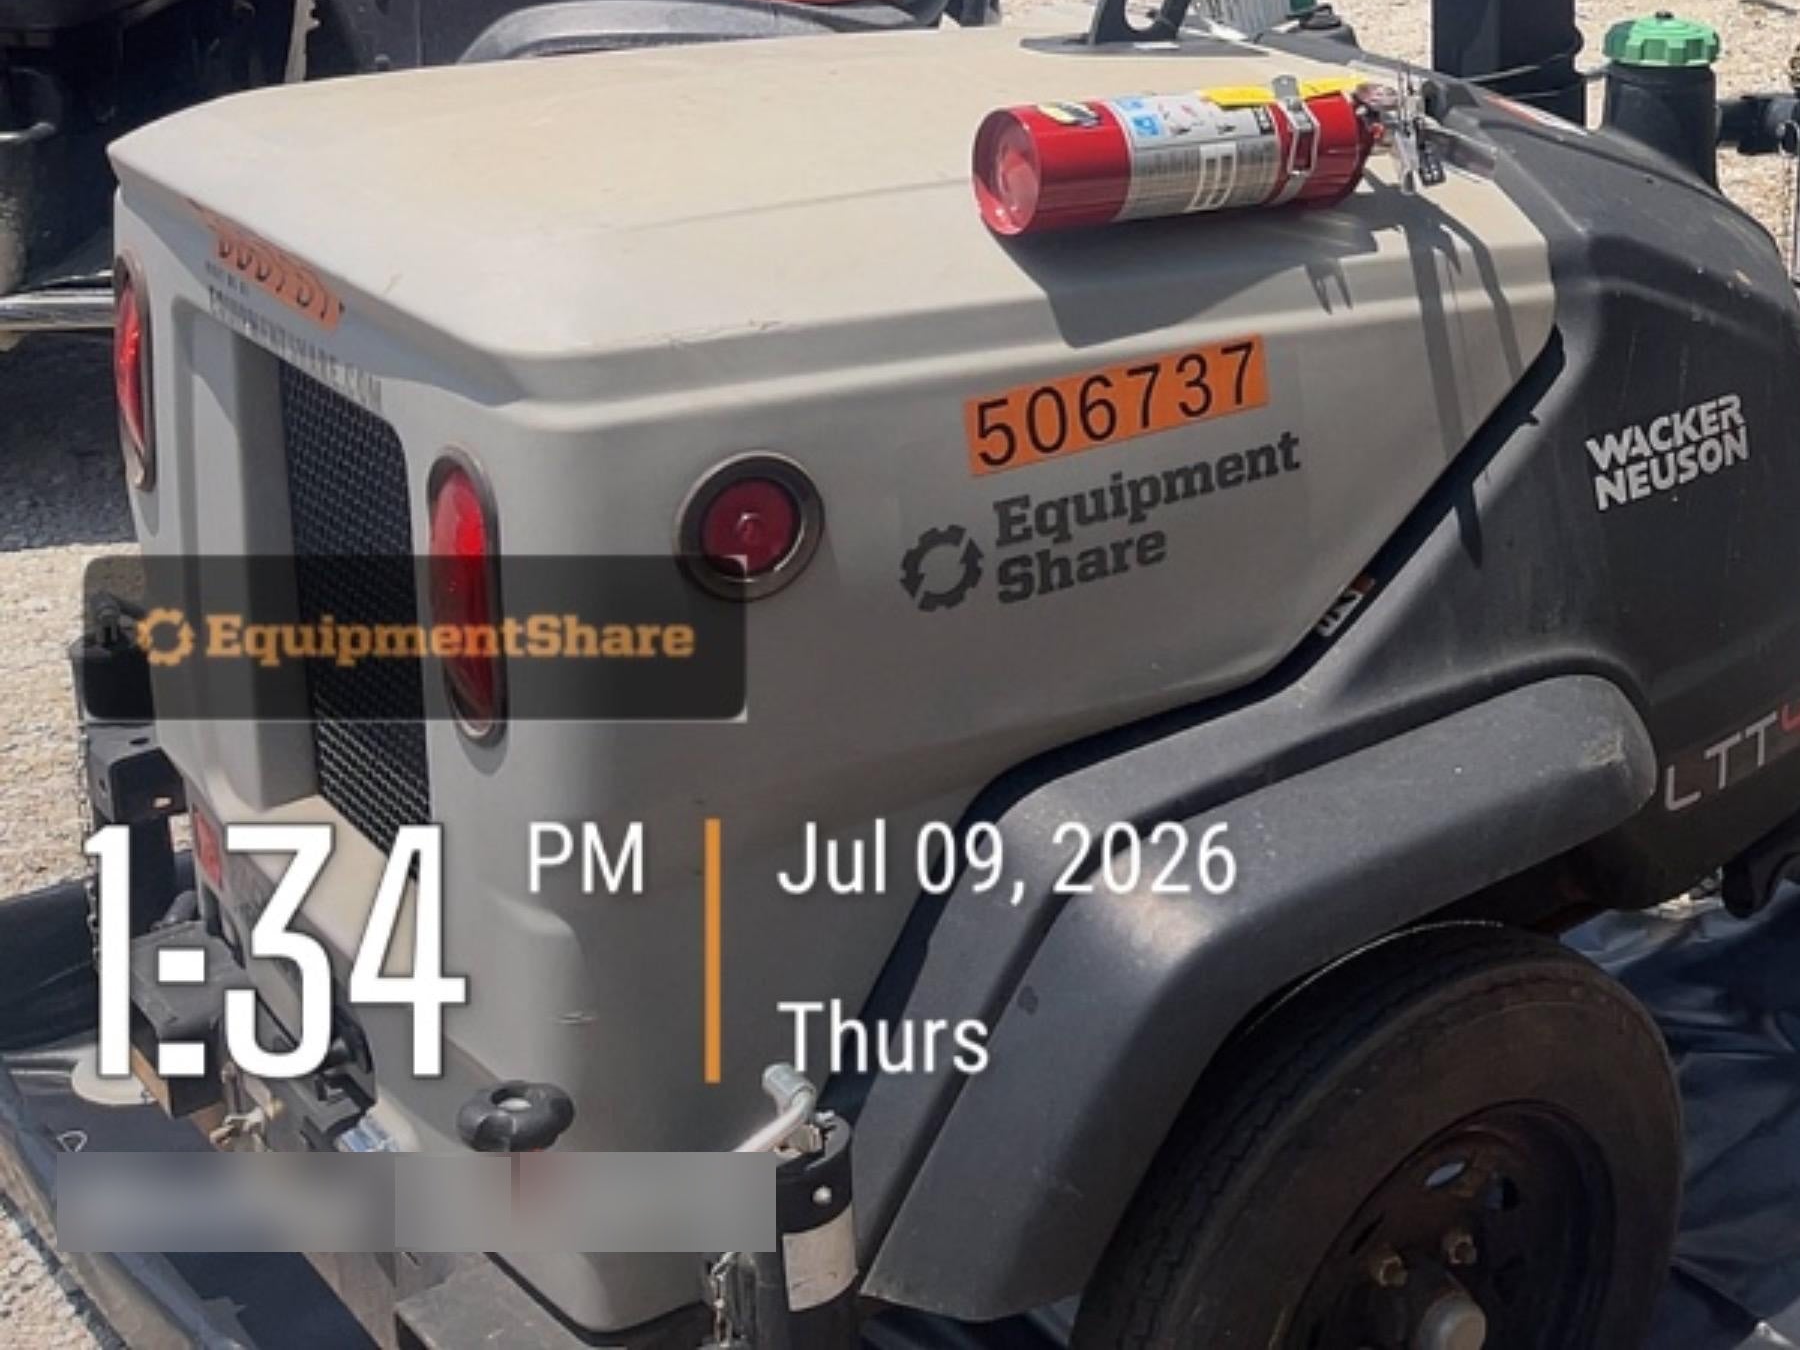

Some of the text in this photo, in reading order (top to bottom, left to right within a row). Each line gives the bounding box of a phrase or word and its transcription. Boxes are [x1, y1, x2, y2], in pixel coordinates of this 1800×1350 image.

[975, 341, 1258, 467] 506737
[1585, 393, 1746, 471] WACKER
[992, 431, 1302, 548] Equipment
[1594, 424, 1750, 511] NEUSON
[994, 528, 1168, 605] Share
